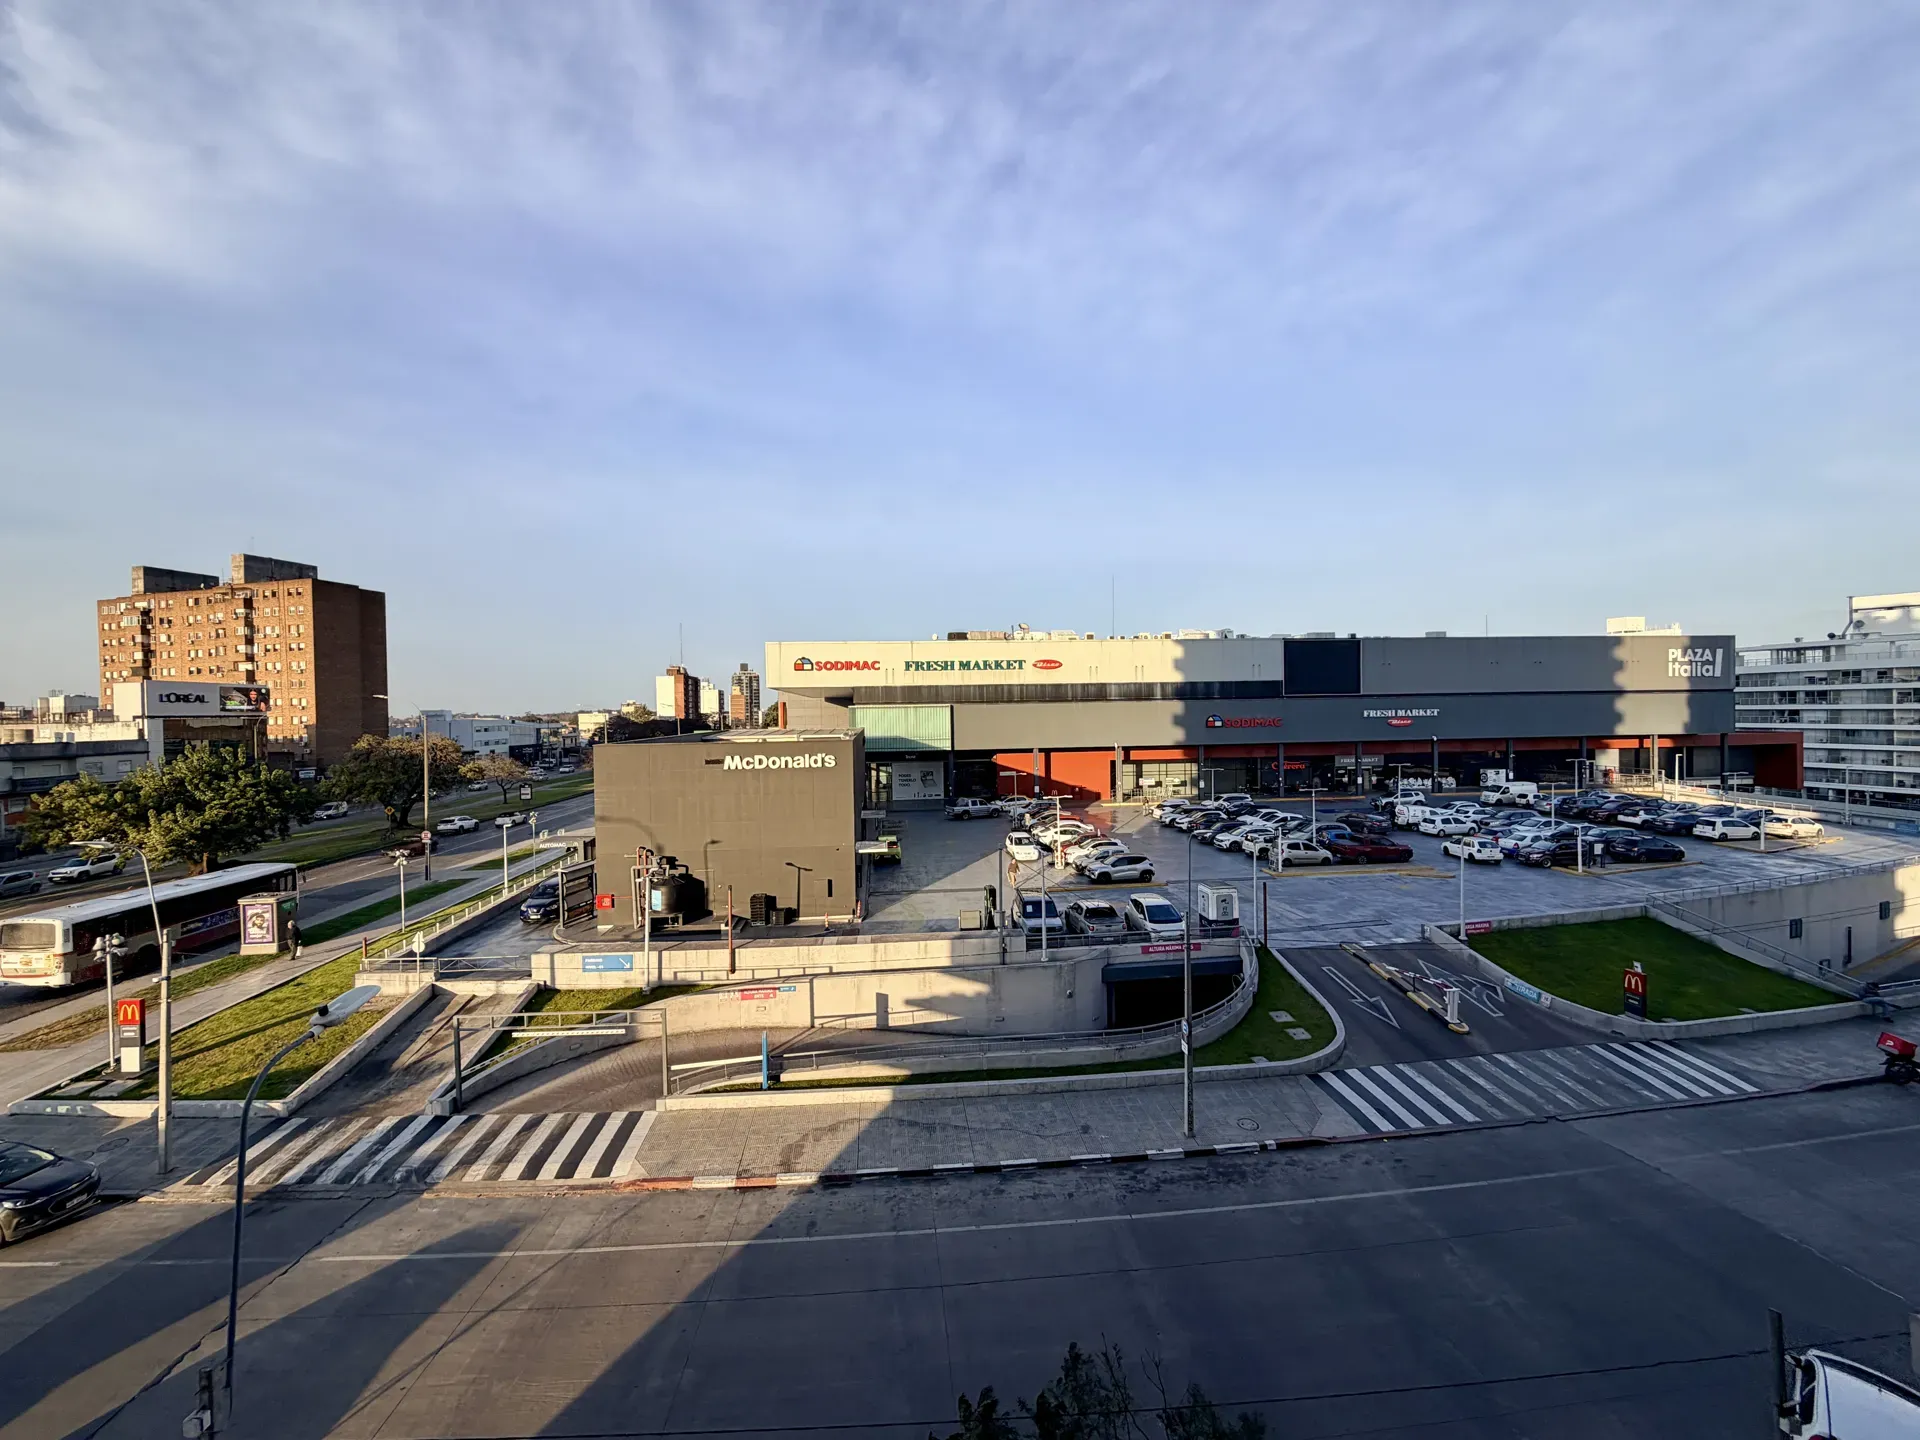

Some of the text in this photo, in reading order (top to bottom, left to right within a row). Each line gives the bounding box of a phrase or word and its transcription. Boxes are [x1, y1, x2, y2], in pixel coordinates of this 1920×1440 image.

[1668, 648, 1713, 661] PLAZA
[815, 660, 880, 671] SODIMAC
[904, 659, 1026, 671] FRESH MARKET
[1668, 661, 1713, 677] Italia
[1363, 709, 1396, 717] FRESH
[1225, 717, 1283, 727] SODIMAC
[723, 753, 836, 770] McDonald's
